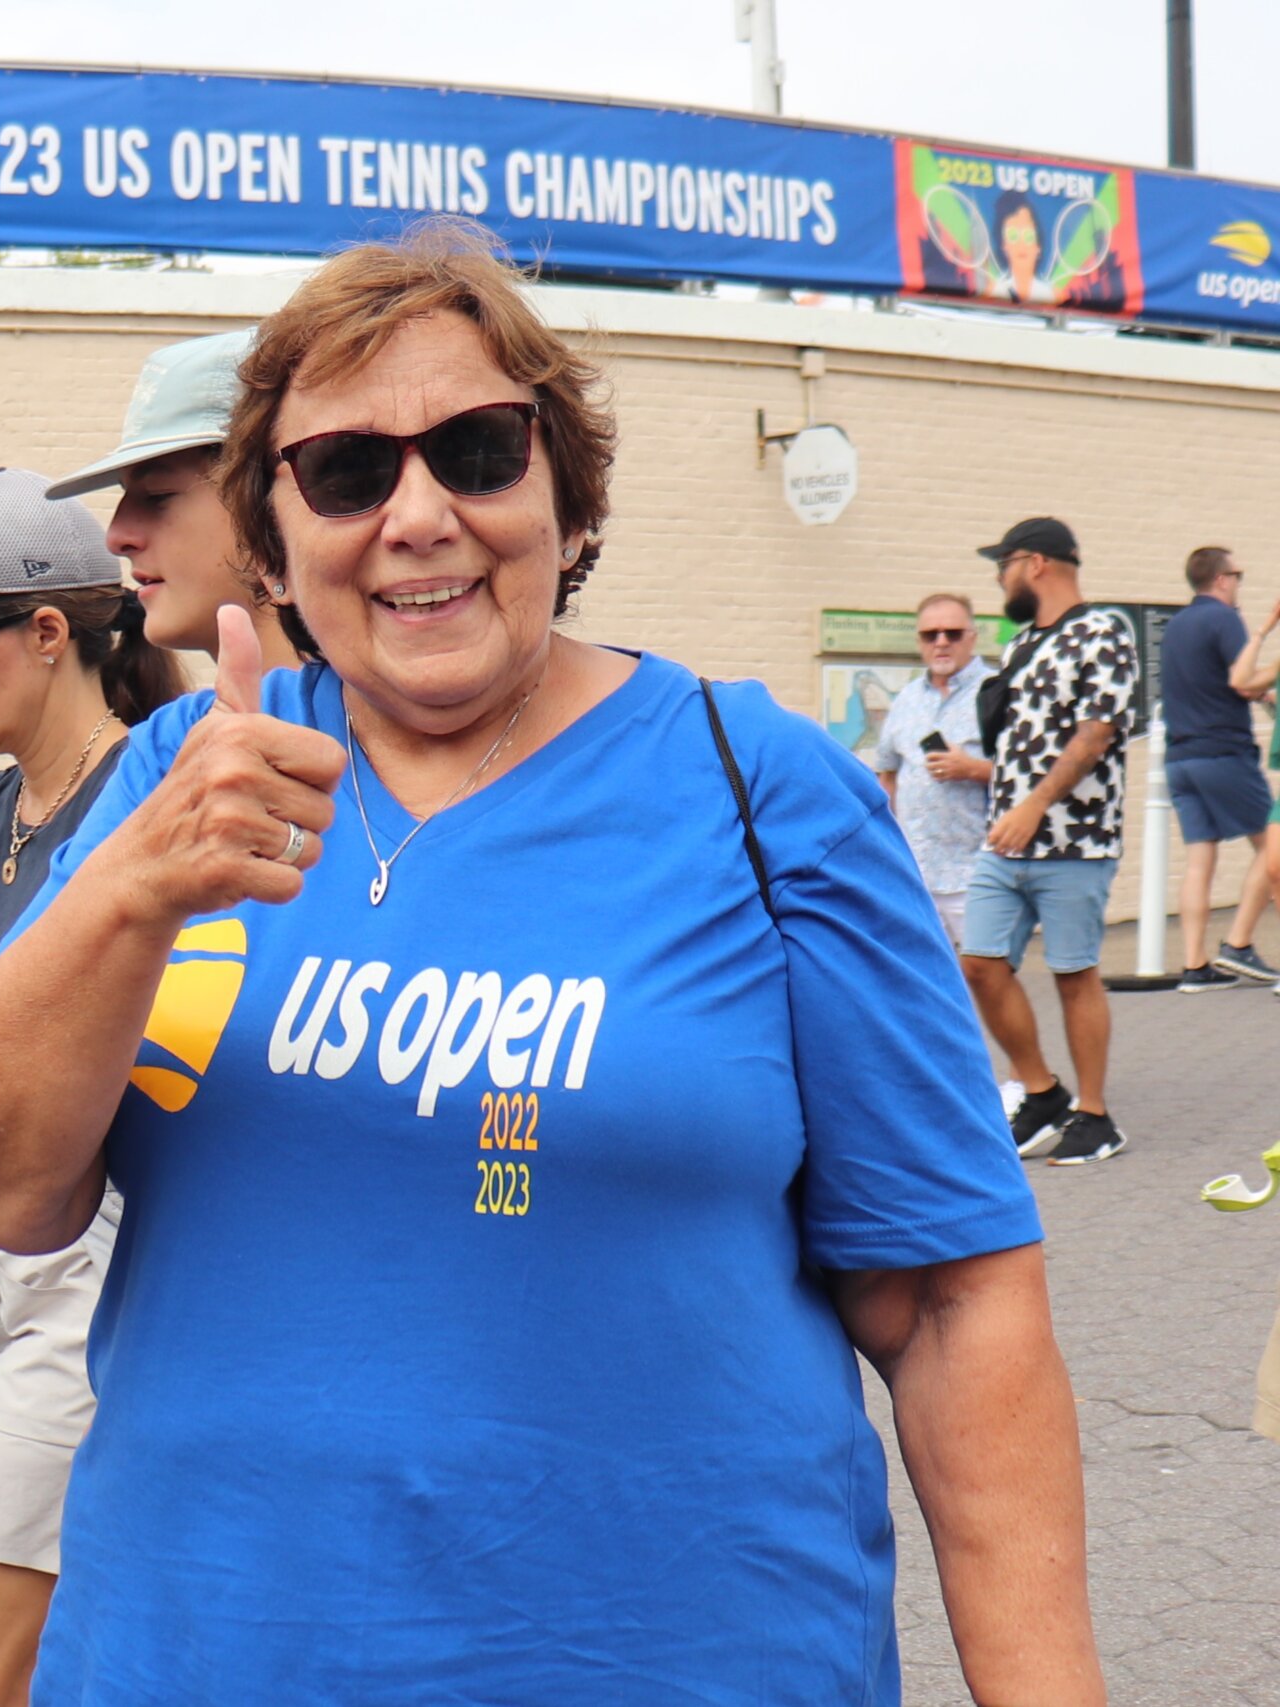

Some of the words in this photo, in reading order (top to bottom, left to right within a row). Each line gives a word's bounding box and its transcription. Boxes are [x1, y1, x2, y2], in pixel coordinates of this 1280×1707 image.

[81, 126, 152, 199] US
[168, 128, 302, 205] OPEN
[317, 136, 490, 216] TENNIS
[504, 149, 839, 248] CHAMPIONSHIPS
[938, 157, 994, 188] 2023
[996, 165, 1030, 193] US
[1033, 169, 1095, 200] OPEN
[1198, 271, 1228, 298] us
[267, 956, 392, 1080] us
[378, 966, 606, 1118] open
[479, 1092, 539, 1151] 2022
[474, 1160, 531, 1216] 2023
